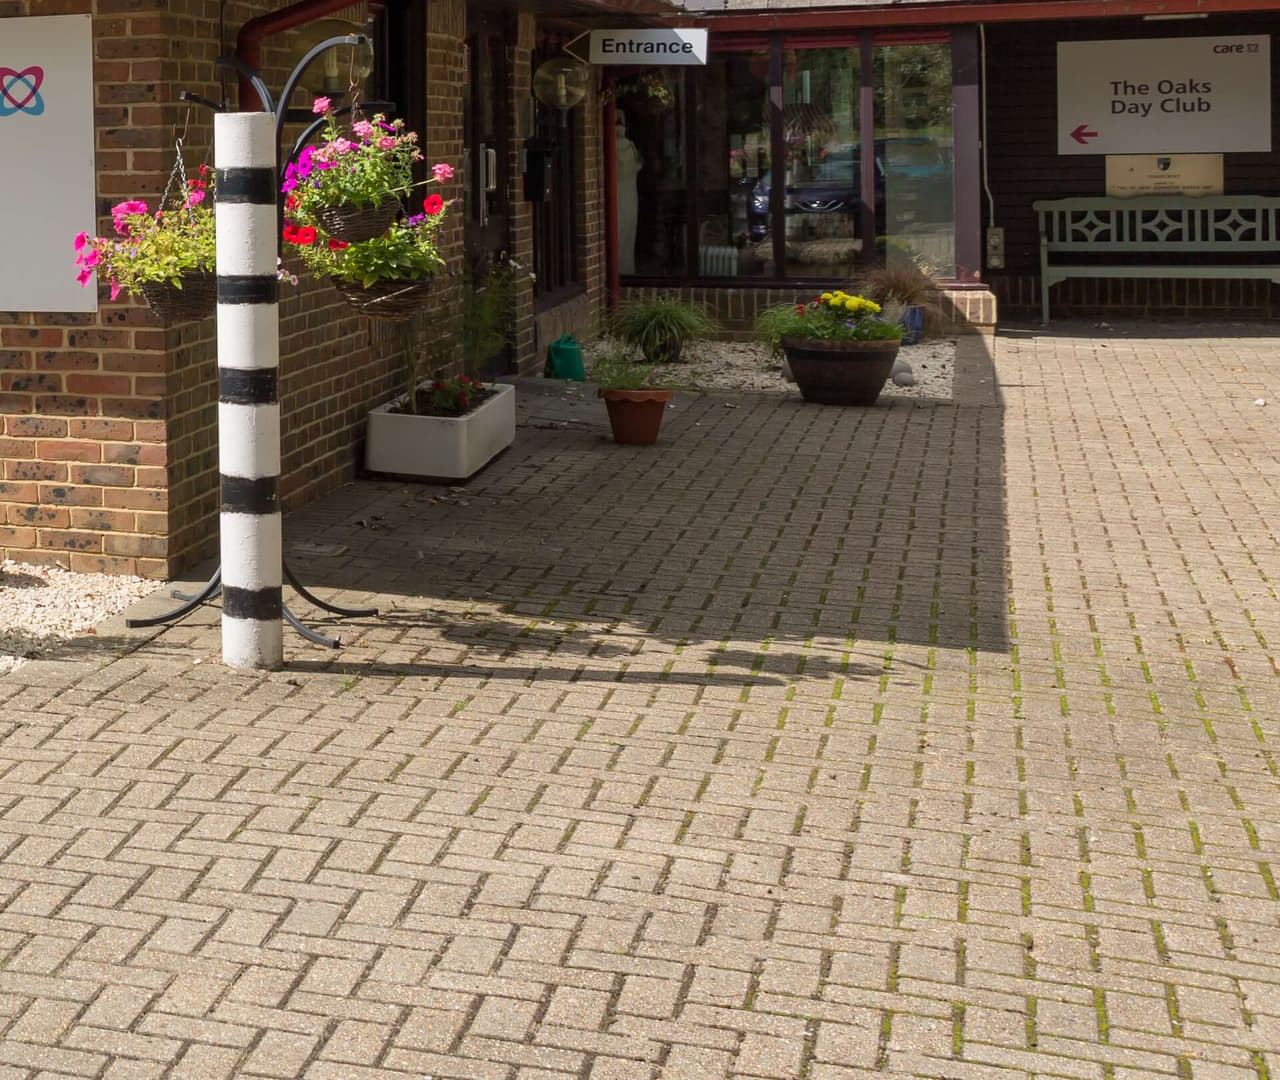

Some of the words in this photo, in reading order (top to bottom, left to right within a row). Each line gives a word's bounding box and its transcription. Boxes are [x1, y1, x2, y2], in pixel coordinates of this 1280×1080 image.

[601, 38, 694, 54] Entrance
[1213, 43, 1244, 54] care
[1110, 80, 1150, 96] The
[1157, 78, 1212, 95] Oaks
[1111, 99, 1153, 118] Day
[1160, 97, 1211, 113] Club
